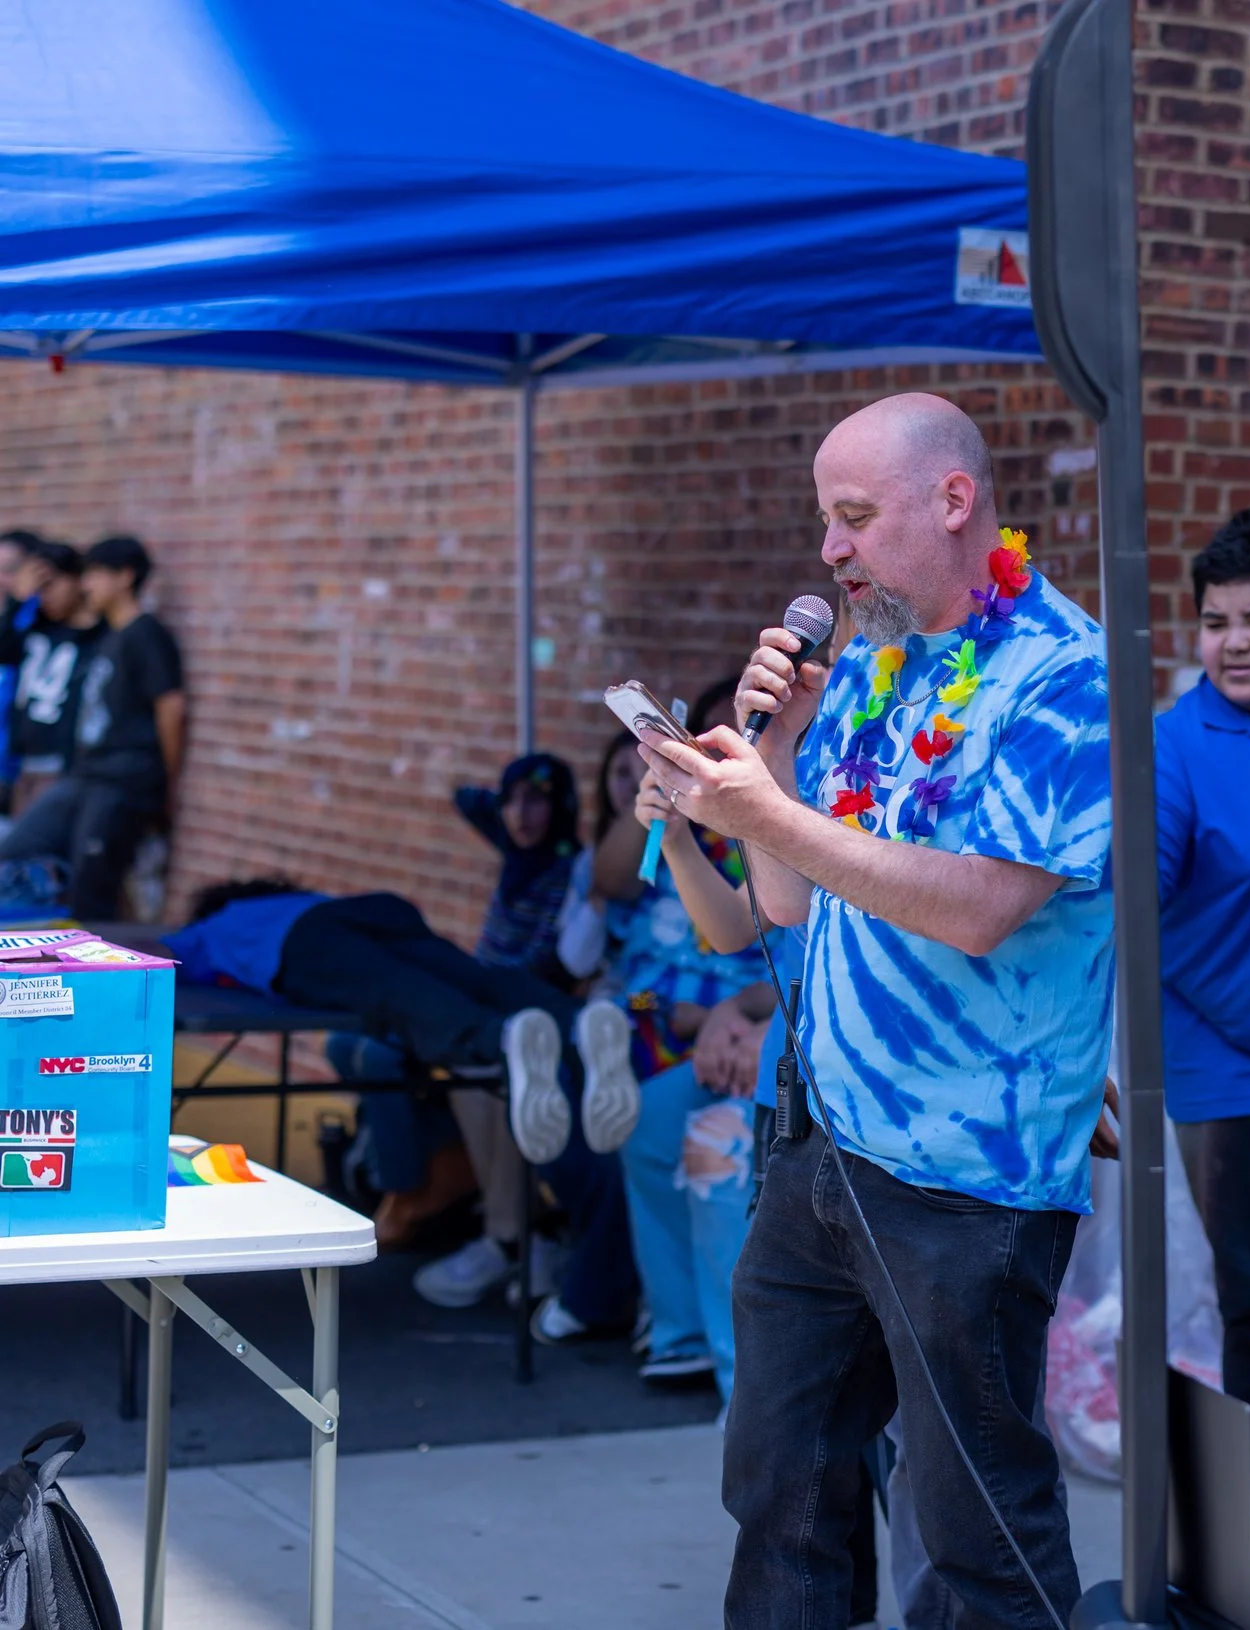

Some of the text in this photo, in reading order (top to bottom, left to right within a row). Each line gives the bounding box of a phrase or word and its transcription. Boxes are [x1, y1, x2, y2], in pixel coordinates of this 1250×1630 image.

[9, 978, 59, 991] JENNIFER
[40, 1054, 151, 1073] NYC Brooklyn 4
[0, 1110, 75, 1136] TONY'S
